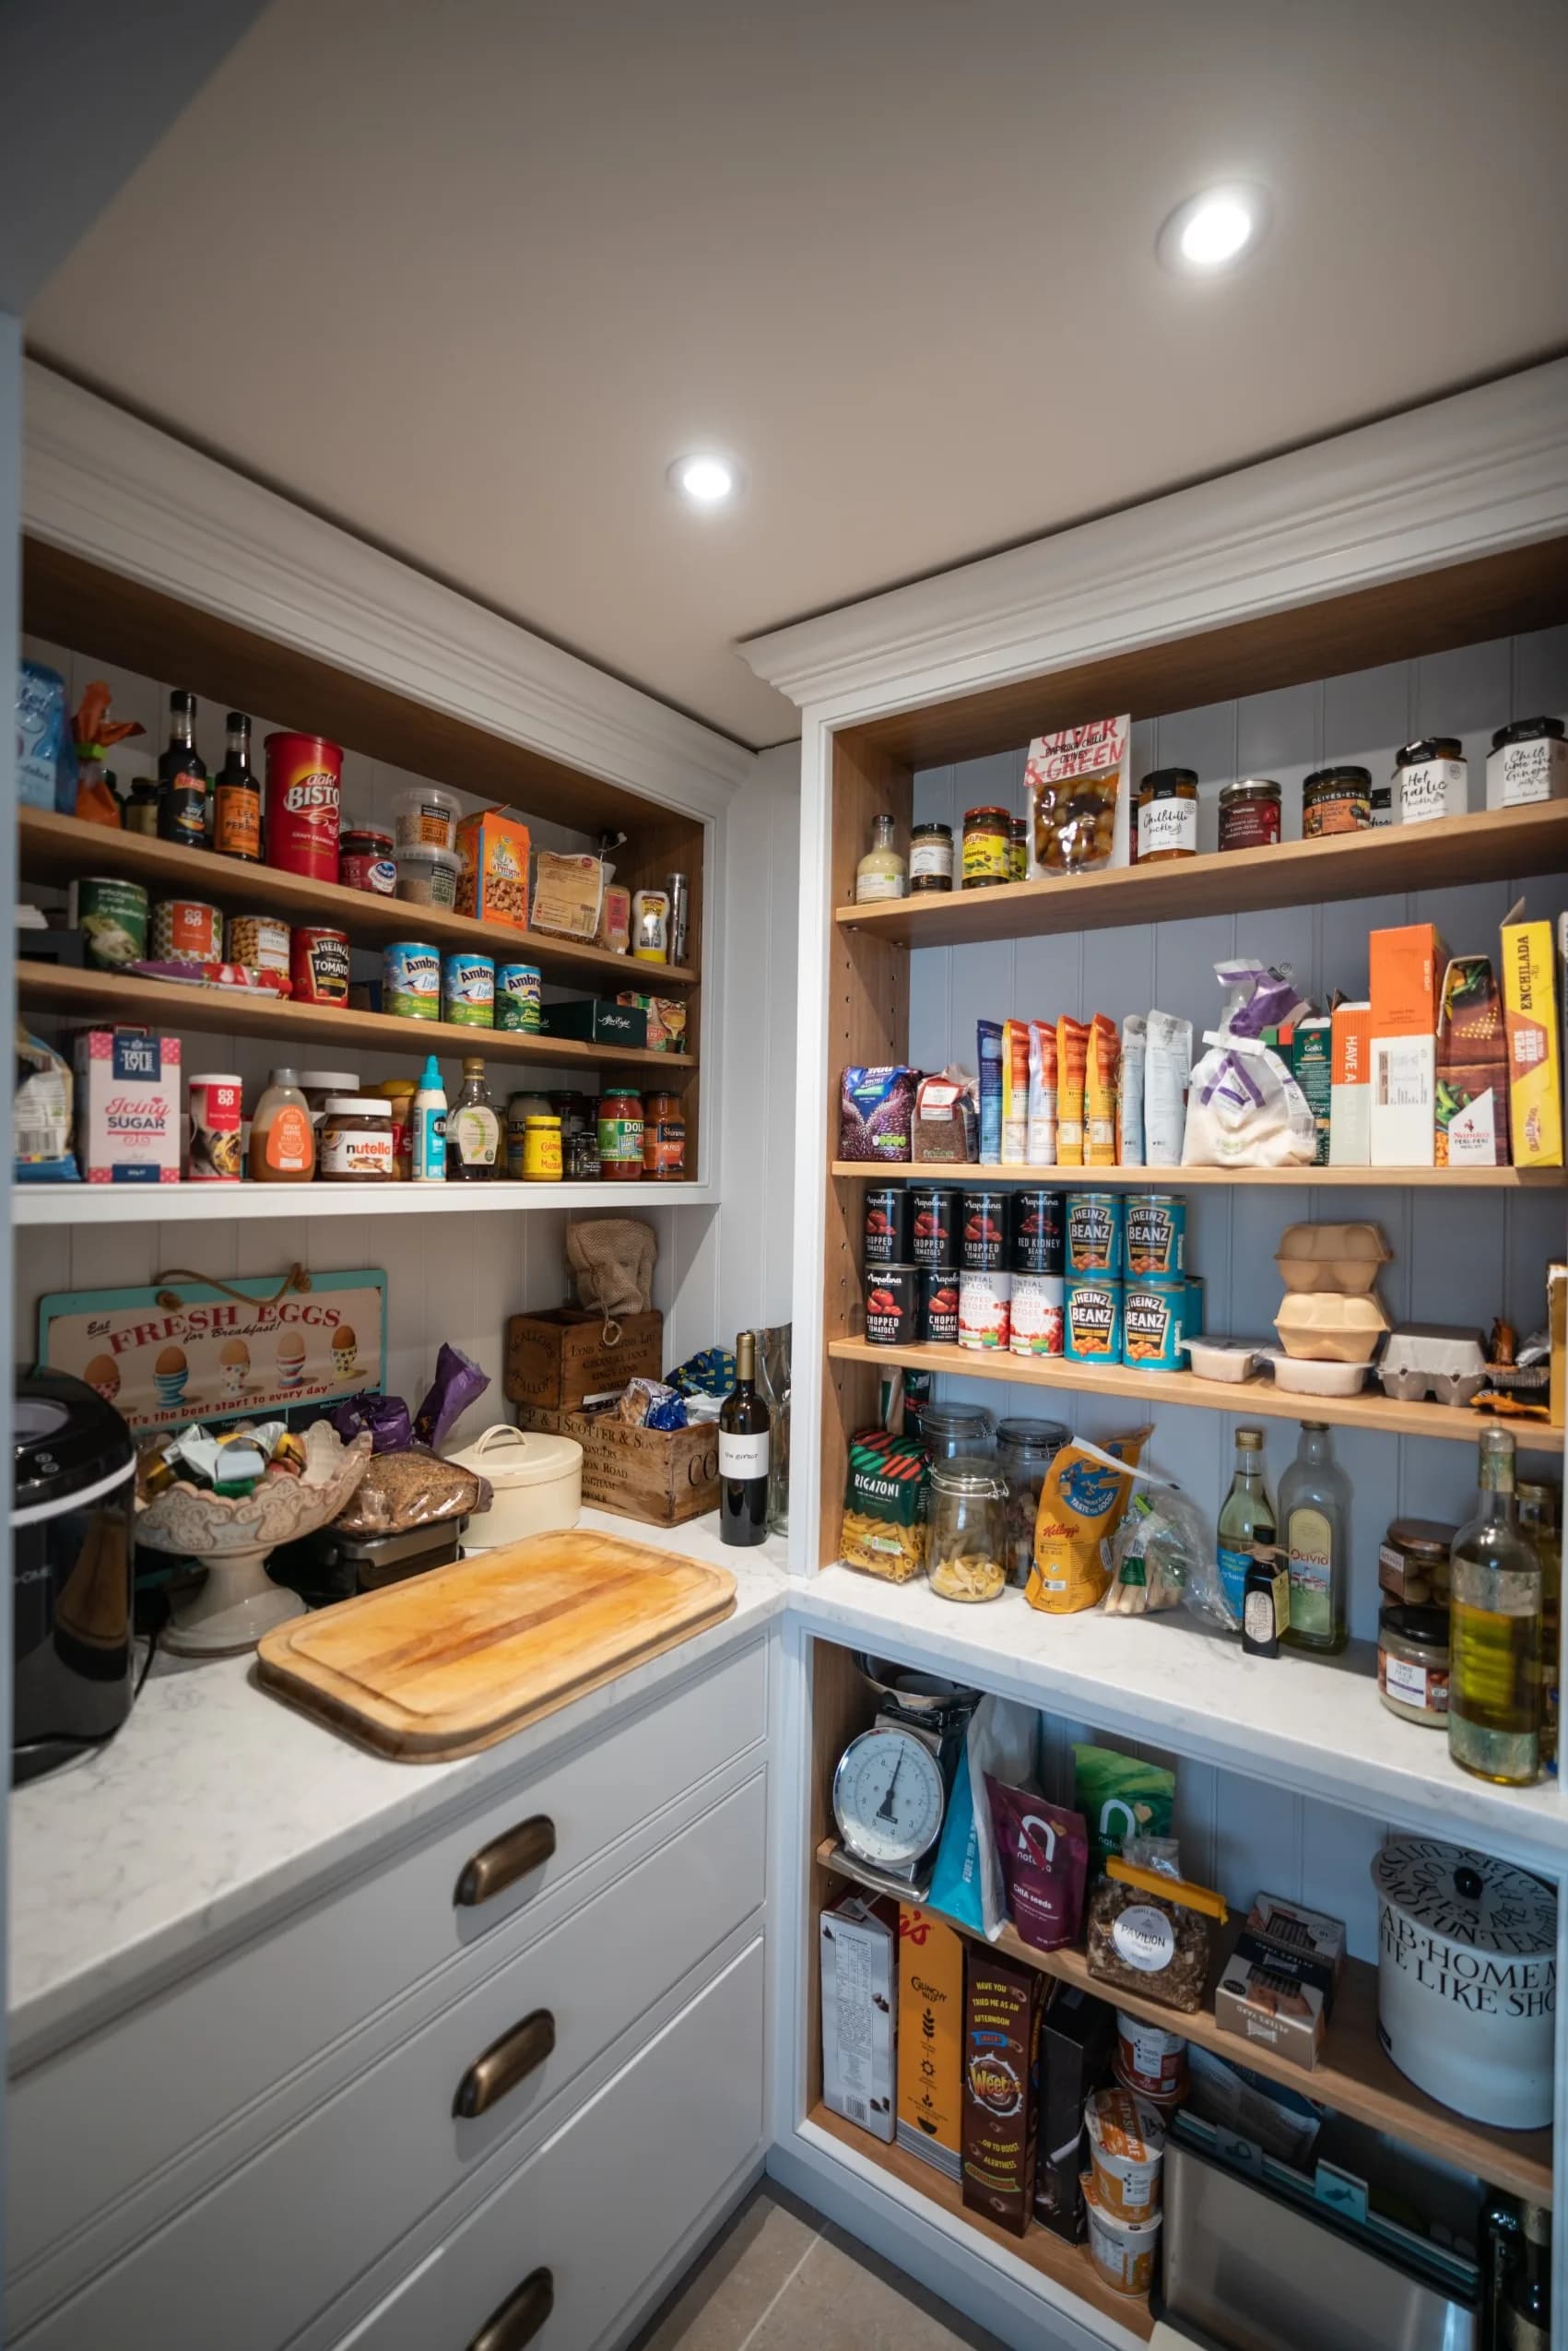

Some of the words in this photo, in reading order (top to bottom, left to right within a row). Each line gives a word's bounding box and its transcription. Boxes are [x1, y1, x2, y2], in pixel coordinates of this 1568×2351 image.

[1041, 718, 1118, 758] SILVER
[1025, 759, 1043, 786] &
[1046, 738, 1126, 780] GREEN
[307, 774, 337, 786] aah!
[1409, 771, 1428, 786] Hot
[285, 786, 339, 810] BISTO
[1400, 781, 1446, 803] Garlic
[314, 960, 348, 975] TOMATO
[1520, 935, 1533, 1010] ENCHILADA
[477, 984, 493, 998] Ligh
[122, 1049, 153, 1061] TATE
[1304, 1045, 1323, 1053] Gallo
[1345, 1035, 1359, 1071] HAVE
[1345, 1073, 1355, 1083] A
[106, 1096, 170, 1120] Icing
[108, 1116, 164, 1130] SUGAR
[347, 1142, 392, 1155] nutella
[867, 1195, 905, 1207] Napolina
[914, 1196, 949, 1210] Napolina
[965, 1199, 1003, 1212] Napolina
[1020, 1196, 1059, 1210] Napolina
[1074, 1209, 1105, 1222] HEINZ
[1132, 1211, 1164, 1224] HEINZ
[1071, 1223, 1109, 1239] BEANZ
[1127, 1224, 1169, 1242] BEANZ
[914, 1238, 945, 1250] CHOPPED
[964, 1243, 1000, 1255] CHOPPED
[1018, 1238, 1031, 1249] RED
[1032, 1238, 1062, 1250] KIDNEY
[914, 1247, 941, 1258] TOMATOES
[967, 1252, 996, 1263] TOMATOES
[1028, 1248, 1049, 1258] BEANS
[867, 1273, 902, 1287] Napolina
[929, 1274, 960, 1288] Napol
[1076, 1291, 1108, 1305] HEINZ
[1128, 1295, 1160, 1310] HEINZ
[867, 1315, 901, 1329] CHOPPED
[928, 1315, 959, 1328] CHOPPE
[1071, 1306, 1111, 1323] BEANZ
[1126, 1310, 1165, 1329] BEANZ
[88, 1320, 112, 1335] Eat
[108, 1305, 238, 1356] FRESH
[257, 1303, 340, 1328] EGGS
[183, 1330, 204, 1344] for
[211, 1321, 282, 1339] Breakfast!
[869, 1325, 897, 1336] TOMATOES
[931, 1325, 959, 1335] TOMATOE
[154, 1409, 177, 1421] the
[182, 1402, 211, 1417] best
[215, 1398, 249, 1412] start
[253, 1394, 265, 1404] to
[268, 1388, 304, 1401] every
[540, 1412, 549, 1426] &
[564, 1419, 616, 1443] SCOTTER
[619, 1430, 629, 1446] &
[603, 1462, 628, 1479] ROAD
[688, 1450, 719, 1486] CO
[854, 1474, 900, 1497] RIGATONI
[1069, 1497, 1090, 1514] TASTE
[1043, 1524, 1080, 1539] Kellogg's
[1291, 1548, 1328, 1566] OLIVIO
[1013, 1883, 1029, 1900] CHIA
[1030, 1895, 1053, 1910] seeds
[1121, 1924, 1166, 1947] PAVILION
[1408, 1906, 1482, 1944] FUN
[1488, 1930, 1560, 1953] TEA
[911, 1976, 947, 2004] CRUNCHY
[975, 1981, 991, 1992] HAVE
[992, 1982, 1007, 1993] YOU
[1416, 1958, 1497, 2014] LIKE
[1505, 1991, 1556, 2017] SHO
[973, 1998, 988, 2009] TRIED
[990, 1999, 999, 2009] ME
[1000, 2000, 1008, 2010] AS
[1009, 2002, 1020, 2013] AN
[974, 2014, 1010, 2026] AFTERNOON
[970, 2064, 1022, 2096] Weetos
[992, 2140, 1001, 2151] TO
[1001, 2140, 1020, 2152] BOOST
[1124, 2125, 1140, 2157] SIMPLE
[983, 2156, 1017, 2168] ALERTNESS
